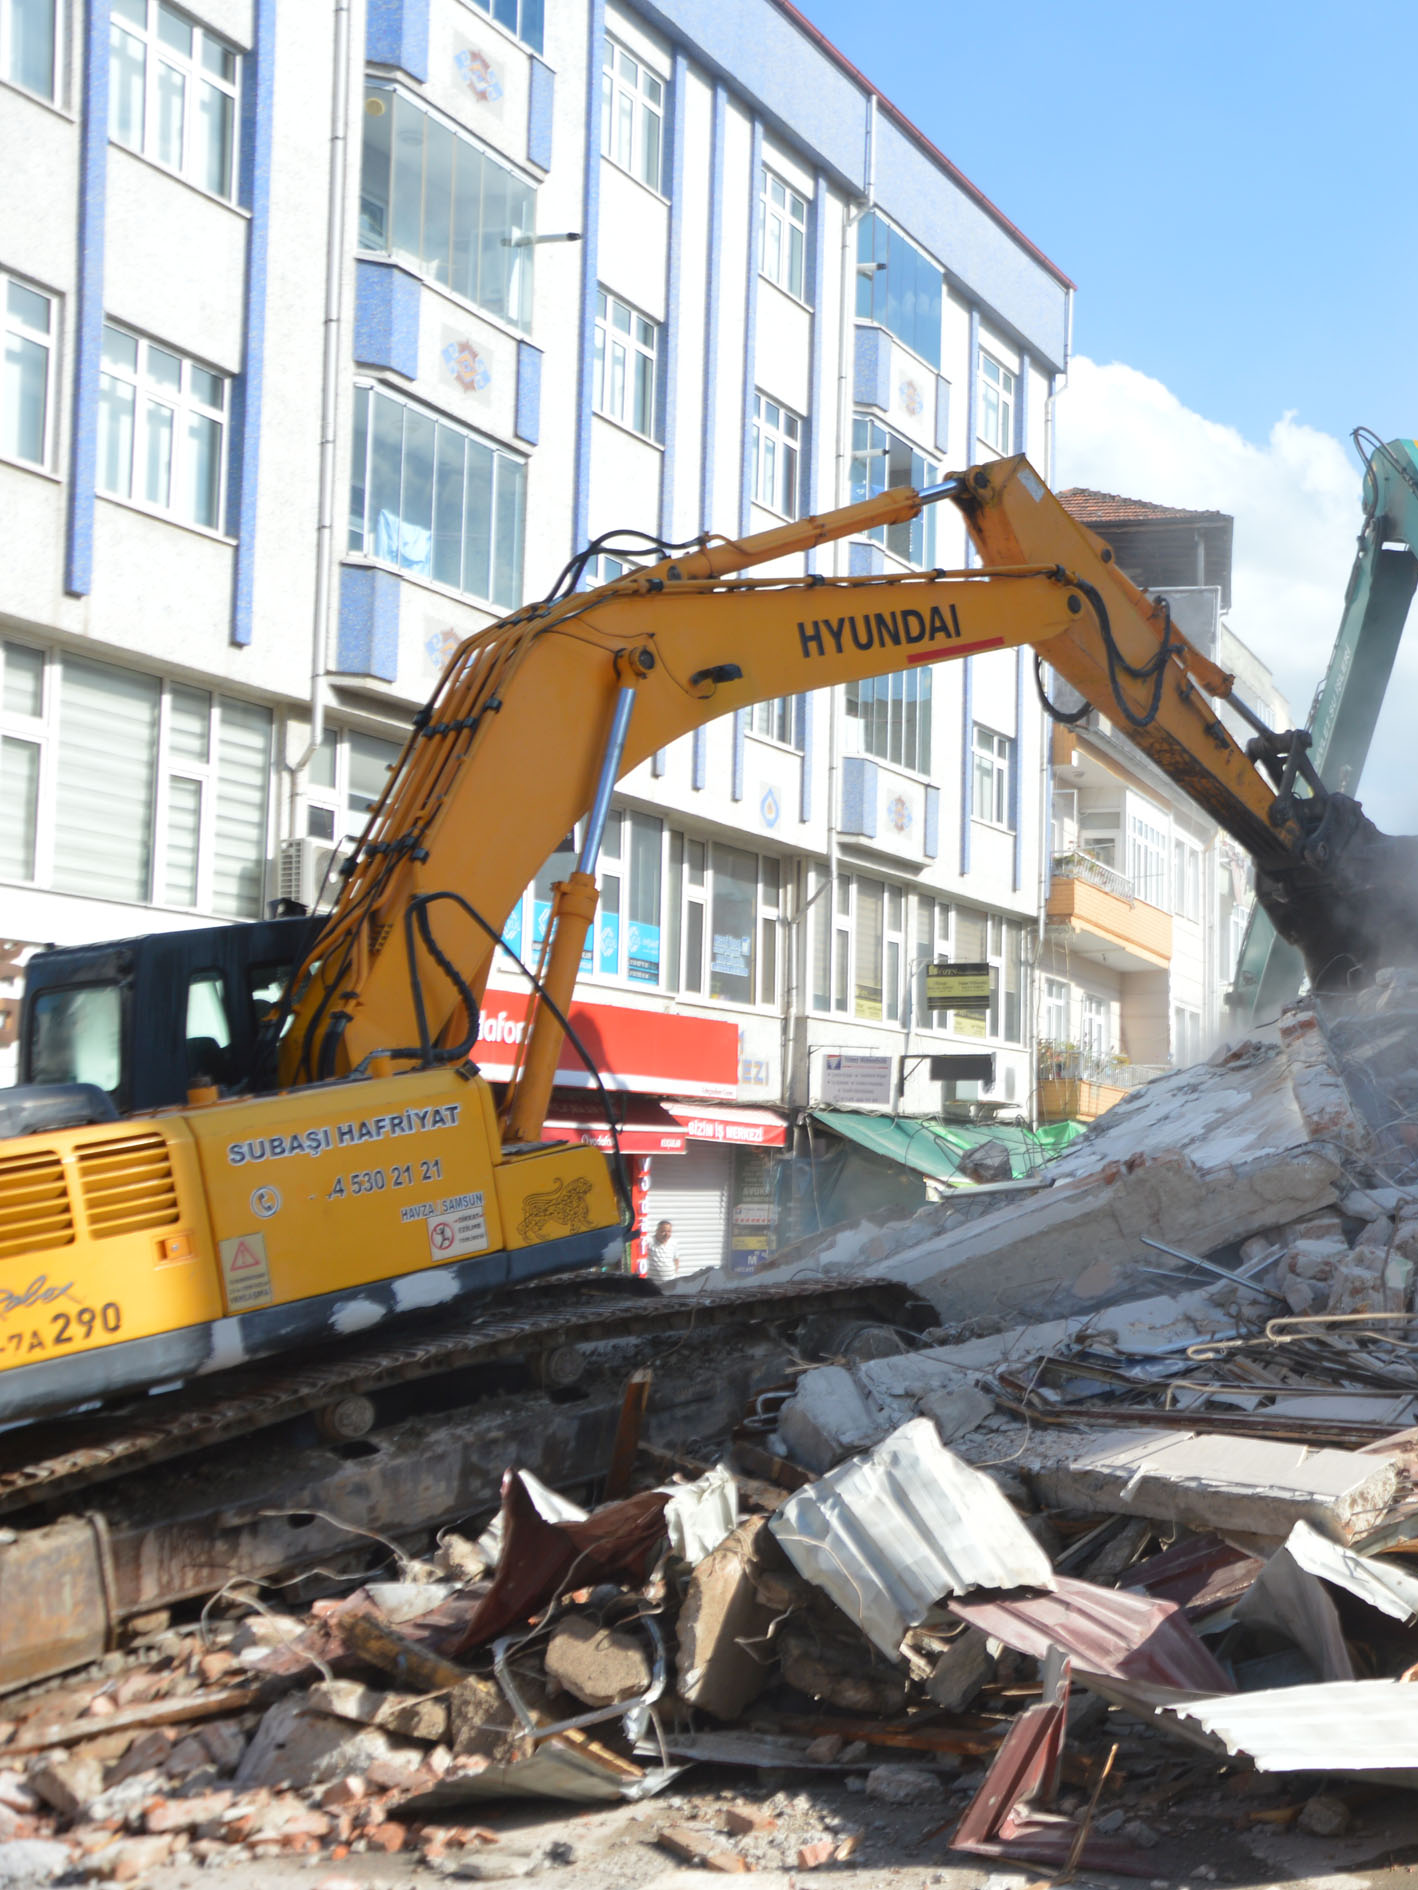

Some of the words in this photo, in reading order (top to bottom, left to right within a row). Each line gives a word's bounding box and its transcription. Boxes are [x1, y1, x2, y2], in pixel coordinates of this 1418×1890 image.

[797, 603, 961, 658] HYUNDAI
[228, 1128, 331, 1165] SUBAŞI
[336, 1104, 461, 1146] HAFRİYAT
[351, 1169, 387, 1195] 530
[391, 1164, 414, 1188] 21
[419, 1158, 443, 1181] 21
[401, 1203, 434, 1223] HAVZA
[441, 1192, 483, 1213] SAMSUN
[50, 1302, 121, 1345] 290
